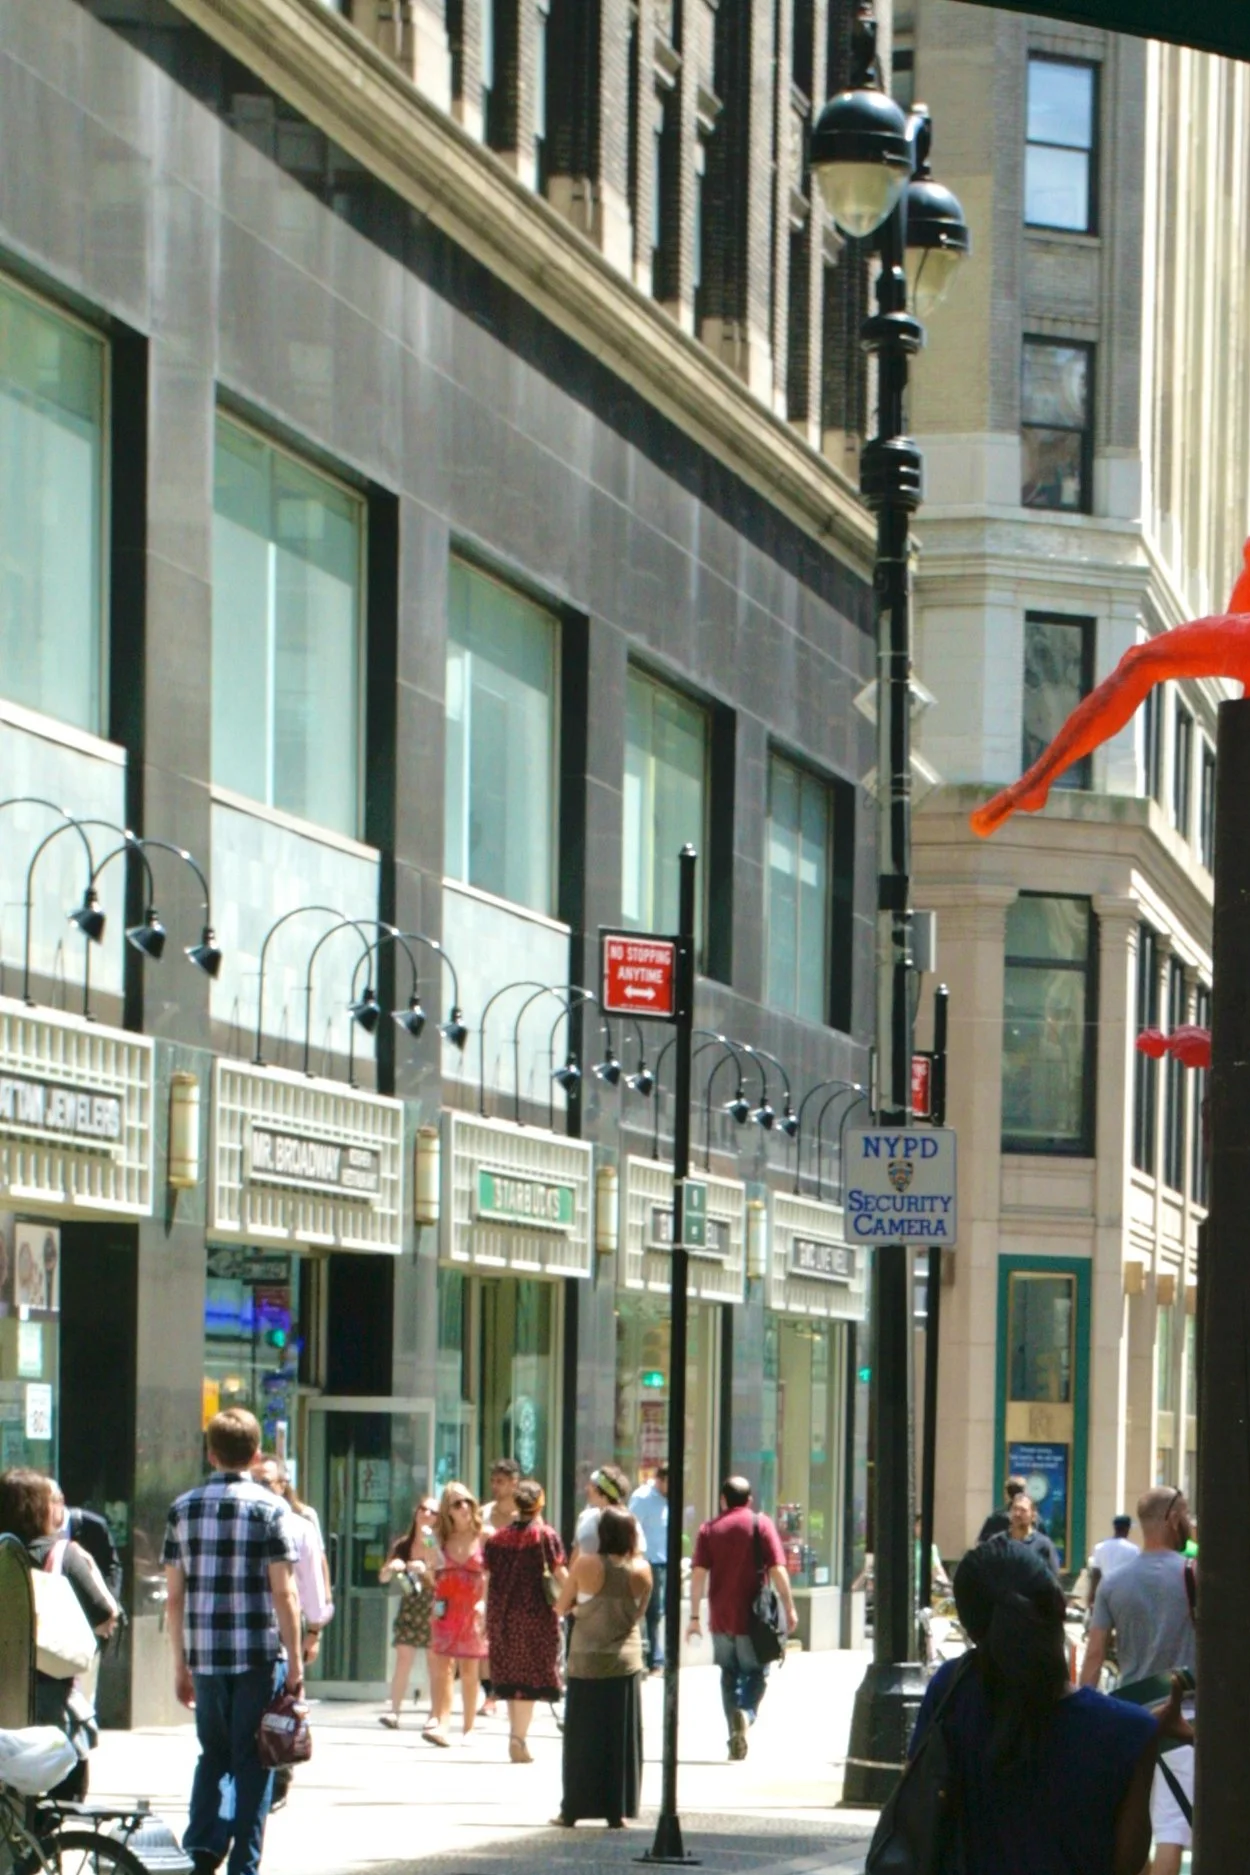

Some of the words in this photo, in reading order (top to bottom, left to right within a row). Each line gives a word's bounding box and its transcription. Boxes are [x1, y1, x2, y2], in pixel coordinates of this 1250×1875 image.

[610, 944, 624, 961] NO
[627, 946, 672, 966] STOPPING
[617, 966, 664, 984] ANYTIME
[276, 1134, 341, 1181] BROADWAY
[862, 1135, 939, 1159] NYPD
[494, 1177, 560, 1220] STARBUCKS
[847, 1190, 952, 1213] SECURITY
[853, 1213, 948, 1237] CAMERA
